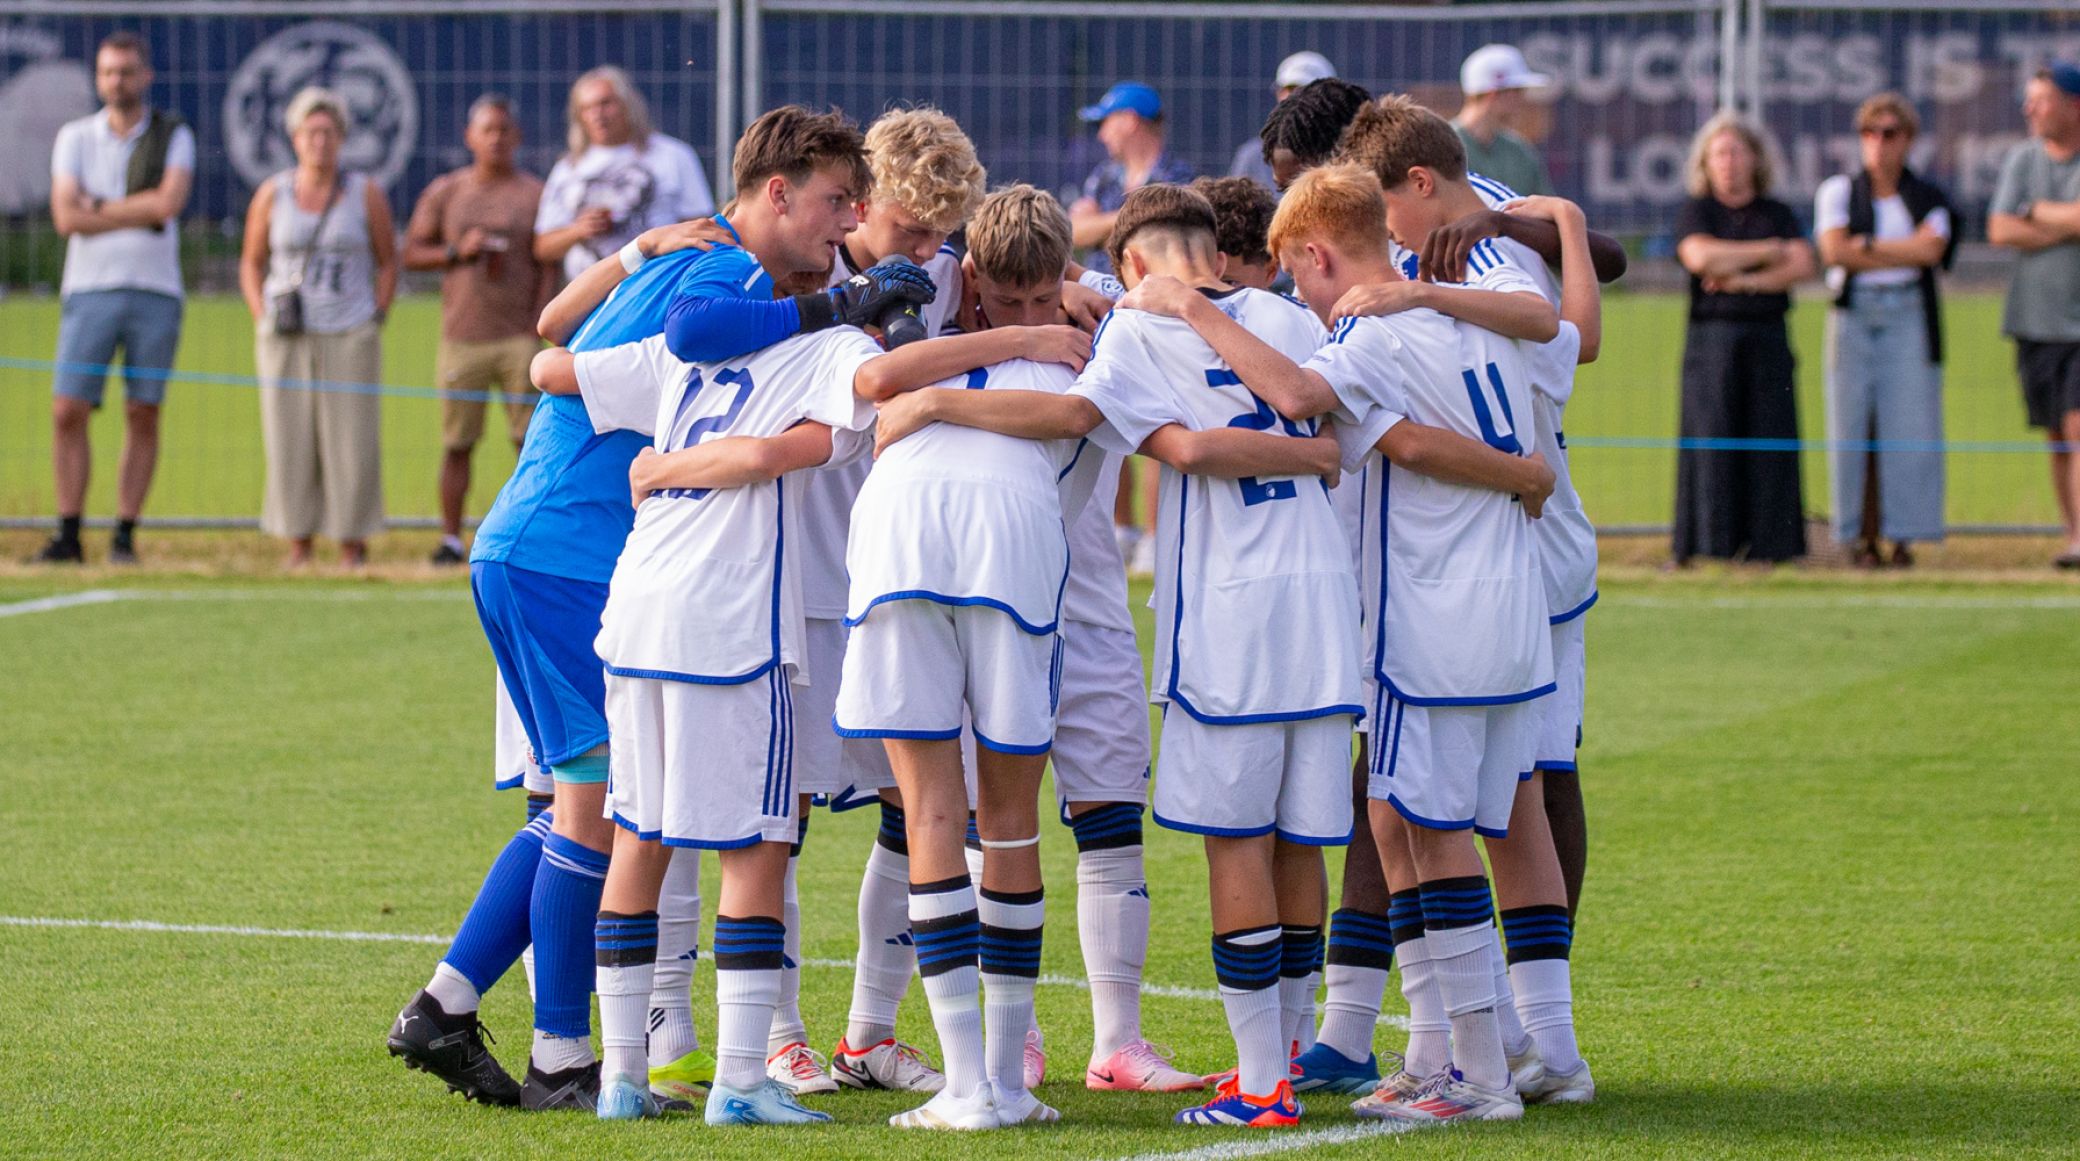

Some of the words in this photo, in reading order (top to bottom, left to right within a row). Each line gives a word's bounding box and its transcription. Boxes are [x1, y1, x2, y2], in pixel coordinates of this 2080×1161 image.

[1521, 31, 1886, 103] SUCCESS
[1905, 31, 1985, 103] IS
[2000, 33, 2080, 100] T
[1589, 133, 1937, 201] LOLT
[650, 366, 755, 501] 12
[1461, 361, 1523, 502] 4
